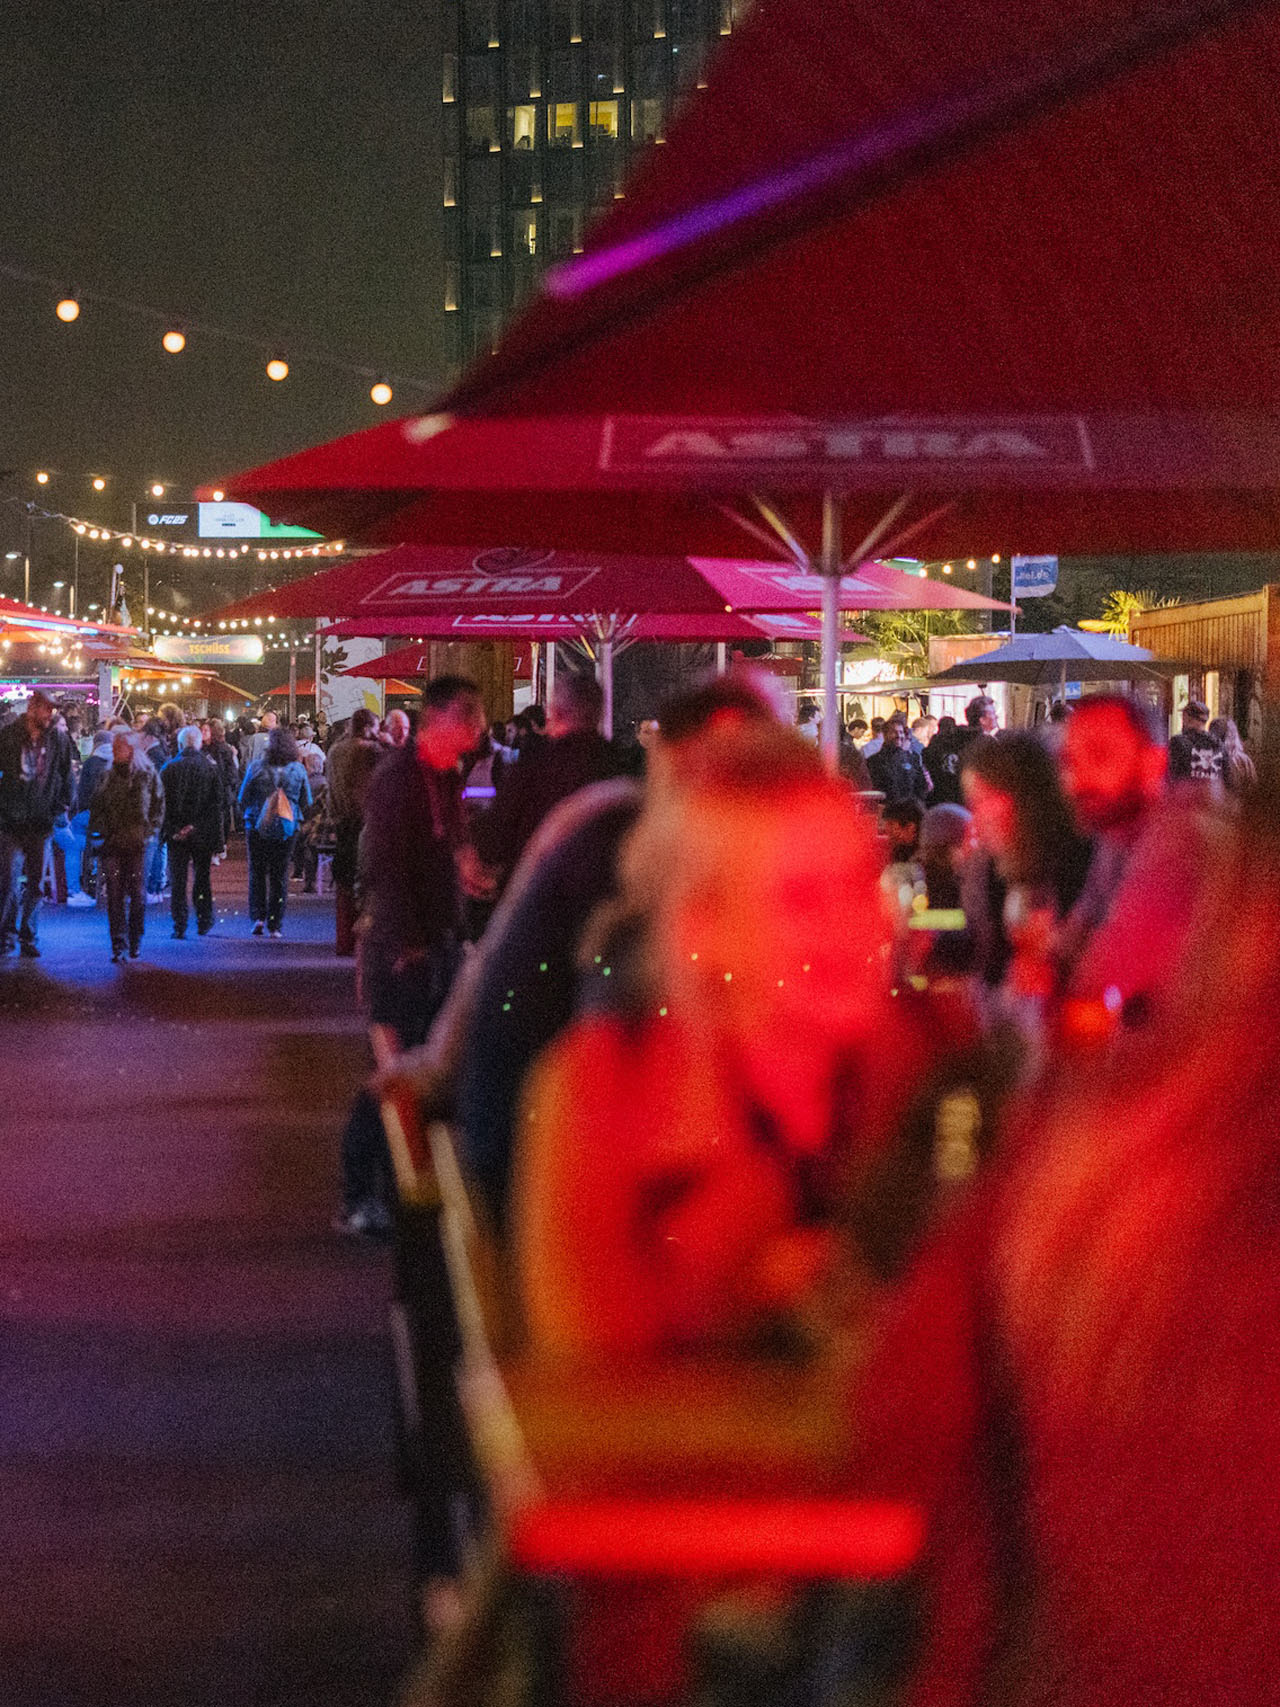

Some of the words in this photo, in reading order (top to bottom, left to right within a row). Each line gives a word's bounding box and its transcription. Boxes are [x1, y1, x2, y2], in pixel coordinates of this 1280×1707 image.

[645, 432, 1047, 458] ASTRA
[388, 575, 563, 597] ASTRA
[189, 642, 231, 655] TSCHÜSS
